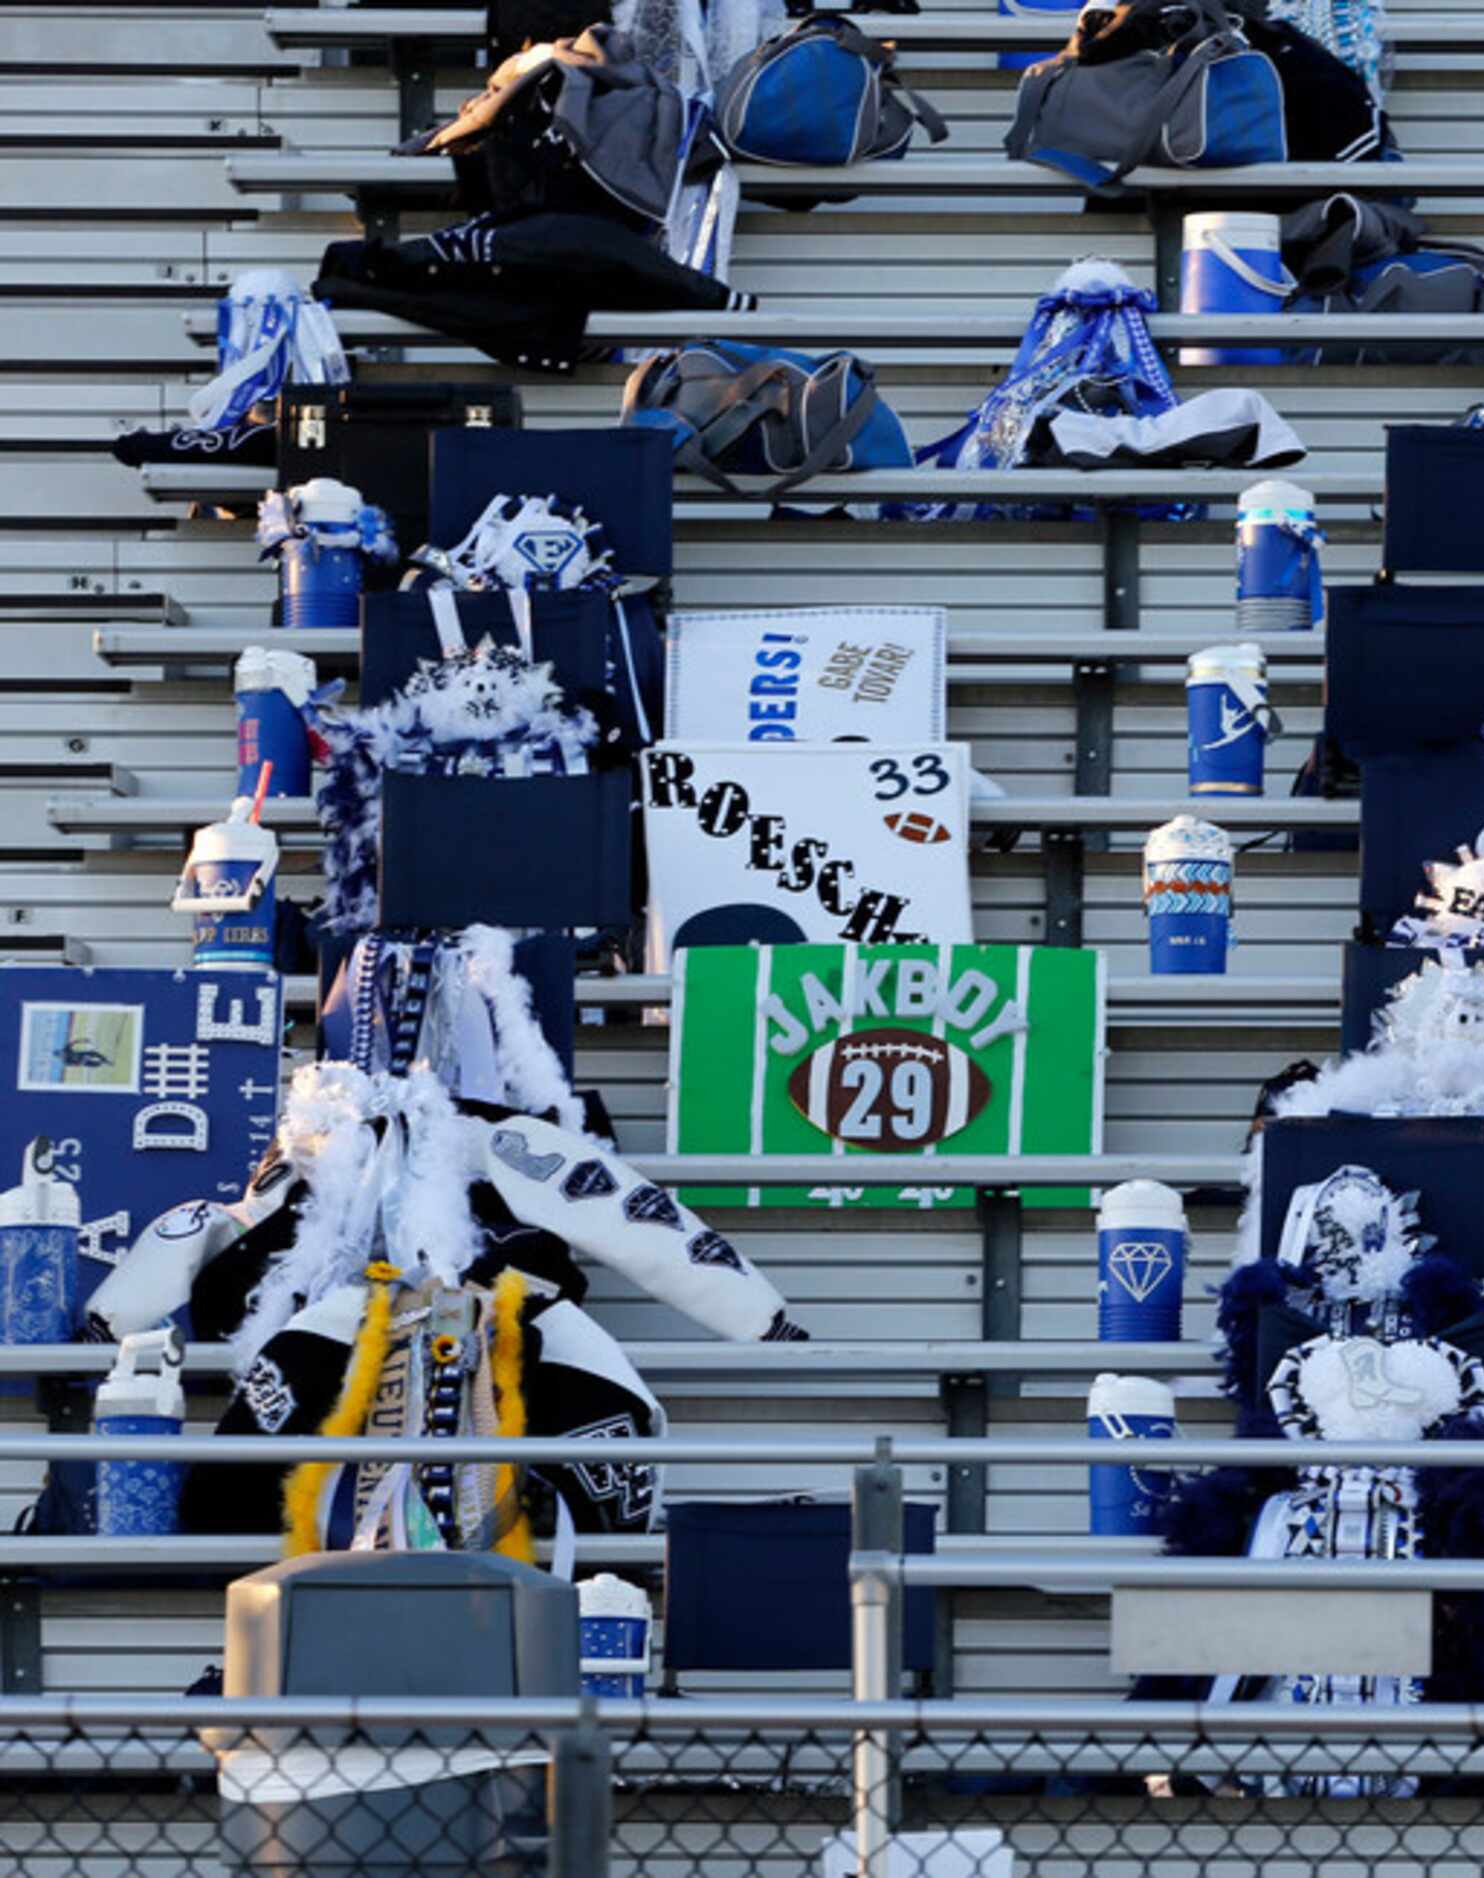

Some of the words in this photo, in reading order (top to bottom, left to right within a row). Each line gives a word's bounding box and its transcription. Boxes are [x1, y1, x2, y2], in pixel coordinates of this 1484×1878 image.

[817, 641, 871, 691] GABE
[853, 642, 915, 703] TOVAR!
[868, 753, 951, 801] 33
[646, 750, 929, 945] ROESCH
[757, 958, 1031, 1057] JAKBOY
[838, 1060, 934, 1140] 29
